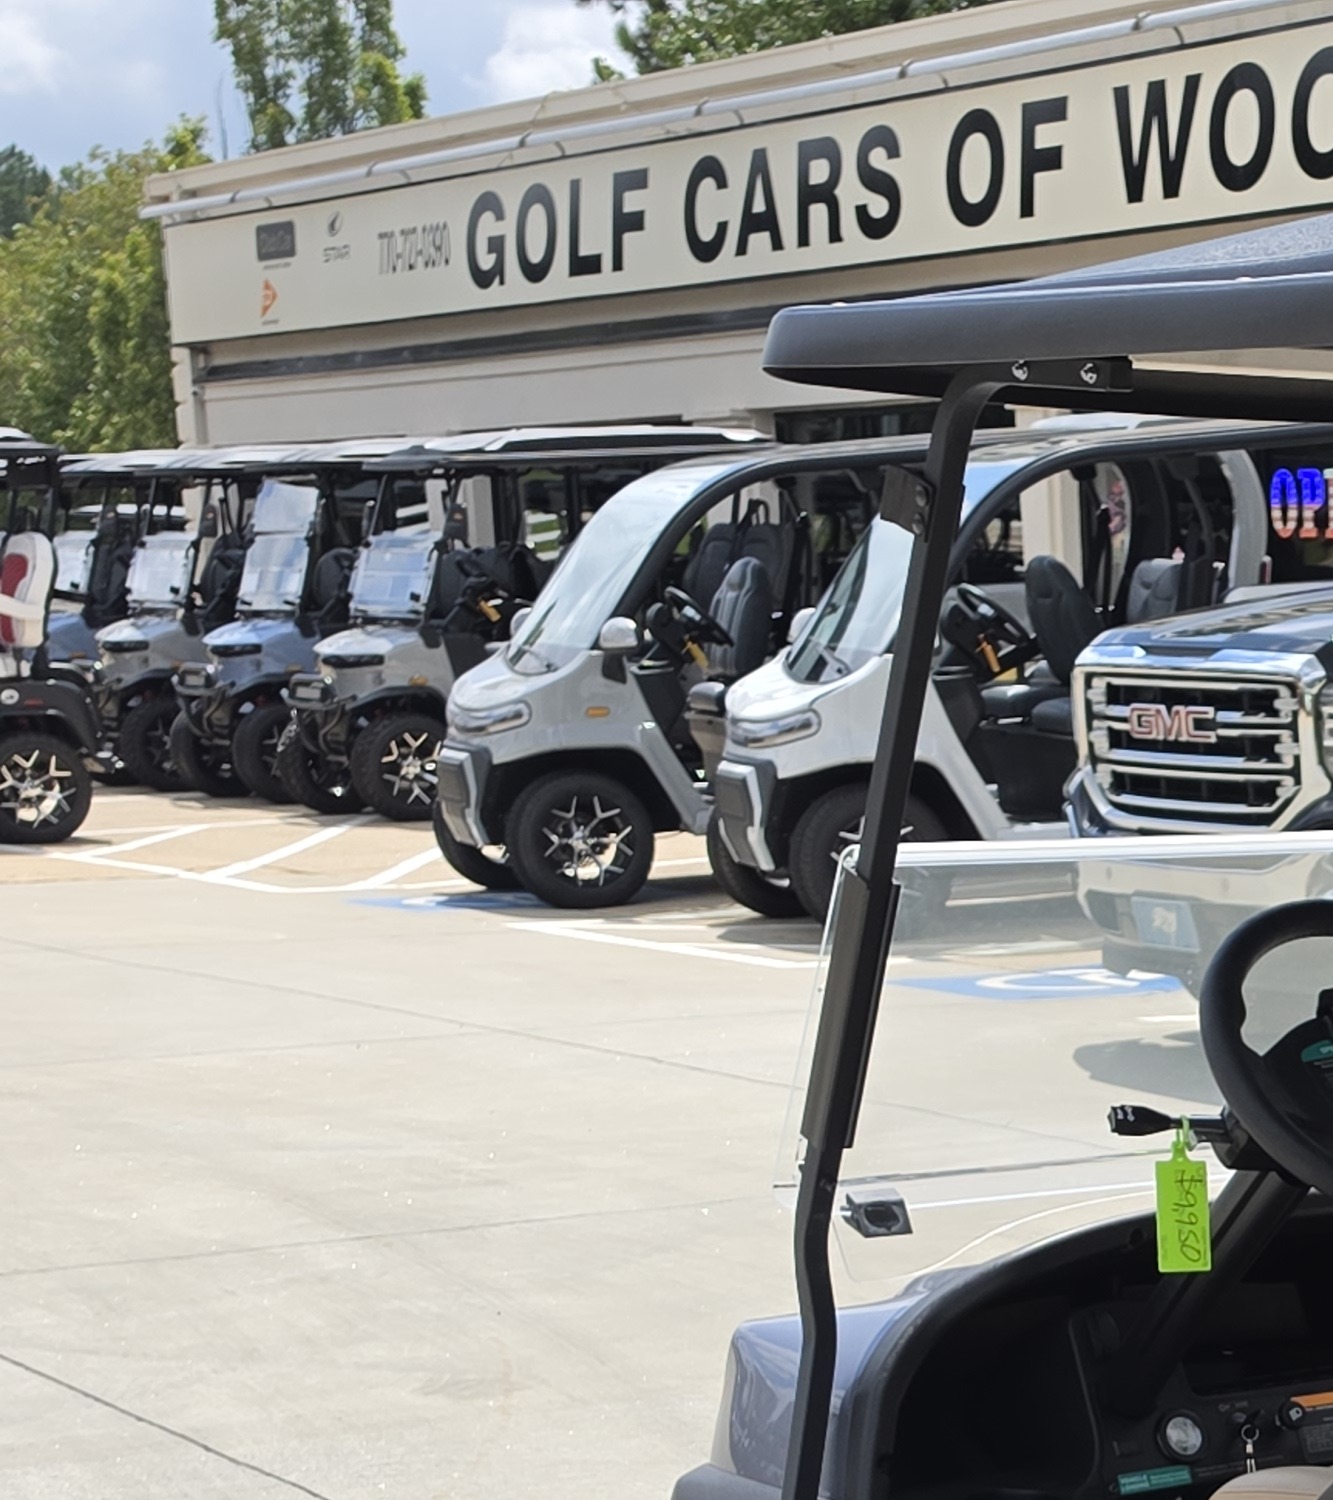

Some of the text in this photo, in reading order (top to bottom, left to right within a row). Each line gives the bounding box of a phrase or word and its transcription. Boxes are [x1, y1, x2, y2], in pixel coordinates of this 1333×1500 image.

[467, 167, 649, 290] GOLF
[684, 124, 902, 263] CARS
[945, 96, 1069, 227] OF
[1129, 703, 1217, 743] GMC
[1172, 1170, 1203, 1263] $9,950
